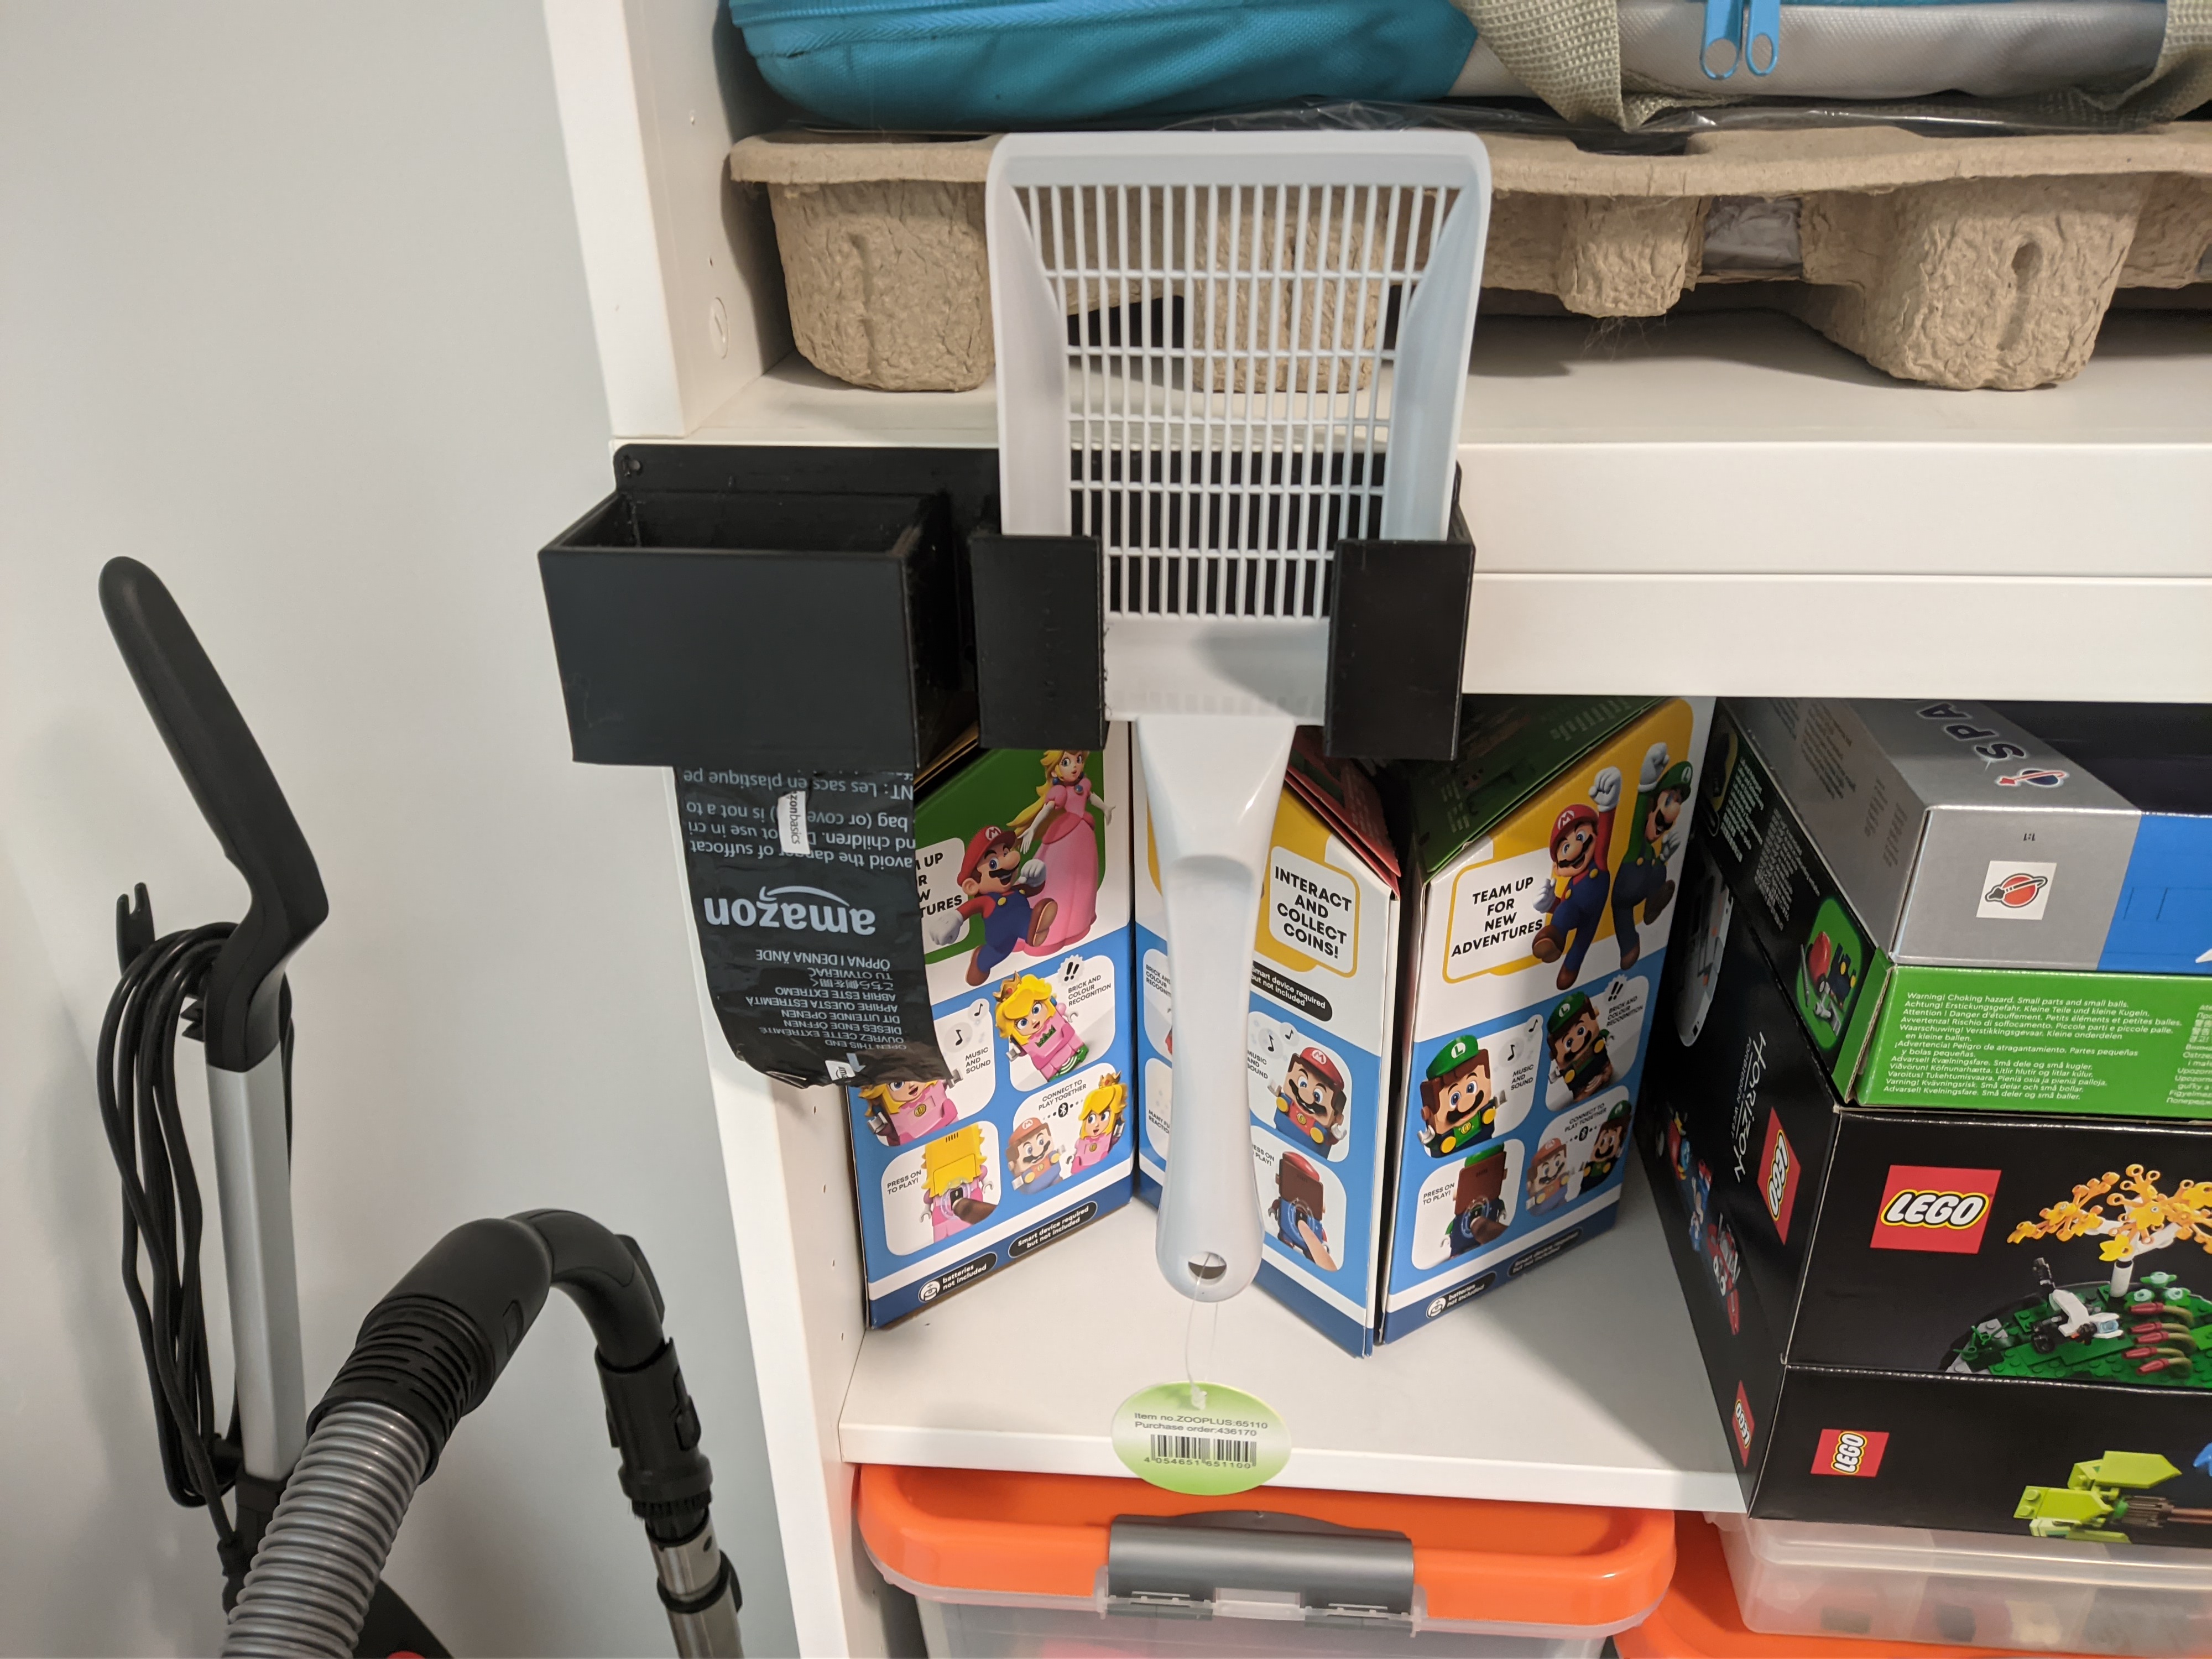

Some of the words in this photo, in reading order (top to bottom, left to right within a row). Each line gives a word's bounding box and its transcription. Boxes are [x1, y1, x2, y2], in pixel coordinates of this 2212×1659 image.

[1918, 702, 2027, 760] SPA
[709, 769, 782, 790] plastique
[788, 778, 807, 789] en
[813, 779, 846, 791] sacs
[851, 782, 877, 797] Les
[686, 802, 702, 816] to
[707, 804, 716, 814] a
[721, 805, 747, 817] not
[753, 808, 764, 822] is
[790, 793, 801, 844] zonbasics
[849, 813, 872, 829] (or
[878, 812, 908, 832] bag
[688, 822, 706, 834] cri
[711, 824, 726, 838] in
[731, 826, 757, 837] use
[690, 841, 753, 857] suffocat
[822, 832, 890, 851] children.
[758, 845, 773, 859] of
[839, 852, 864, 867] the
[870, 855, 912, 870] avoid
[924, 853, 943, 867] UP
[1275, 865, 1352, 912] INTERACT
[1473, 883, 1512, 905] TEAM
[1515, 877, 1534, 893] UP
[1295, 894, 1328, 919] AND
[1486, 899, 1514, 916] FOR
[704, 895, 876, 935] amazon
[1484, 912, 1516, 932] NEW
[1277, 902, 1347, 944] COLLECT
[1284, 923, 1339, 959] COINS!
[1451, 919, 1543, 957] ADVENTURES
[755, 950, 790, 964] ÄNDE
[794, 952, 837, 966] DENNA
[847, 956, 890, 971] ÖPPNA
[875, 972, 893, 980] TU
[1068, 981, 1086, 994] BRICK
[1087, 974, 1102, 987] AND
[1068, 984, 1095, 999] COLOUR
[1272, 974, 1295, 993] device
[1296, 988, 1326, 1009] required
[775, 987, 828, 998] EXTREMO
[831, 990, 859, 1000] ESTE
[862, 992, 896, 1001] ABRIR
[1068, 983, 1112, 1006] RECOGNITION
[1262, 979, 1274, 991] not
[1275, 985, 1305, 1007] included
[1907, 992, 1945, 1001] Warning!
[1948, 994, 1983, 1003] Choking
[1985, 995, 2014, 1003] hazard.
[745, 997, 807, 1008] ESTREMITÀ
[810, 1000, 855, 1011] QUESTA
[858, 1003, 898, 1013] APRIRE
[1905, 1000, 1943, 1009] Achtung!
[1945, 1002, 2021, 1012] Erstickungsgefahr.
[781, 1009, 827, 1020] OPENEN
[830, 1013, 879, 1022] UITEINDE
[883, 1015, 900, 1024] DIT
[1903, 1008, 1942, 1016] Attention
[1949, 1010, 1980, 1019] Danger
[2071, 1014, 2109, 1022] éléments
[2154, 1018, 2182, 1026] balles.
[784, 1020, 828, 1031] ÖFFNEN
[832, 1022, 859, 1031] ENDE
[863, 1024, 901, 1035] DIESES
[1901, 1016, 1949, 1024] Avvertenza!
[1994, 1020, 2053, 1029] soffocamento.
[822, 1031, 857, 1040] CETTE
[1900, 1024, 1963, 1034] Waarschuwing!
[1966, 1027, 2044, 1037] Verstikkingsgevaar.
[860, 1034, 904, 1043] OUVREZ
[965, 1047, 989, 1061] MUSIC
[1895, 1040, 1950, 1048] ¡Advertencia!
[1953, 1042, 1981, 1051] Peligro
[1996, 1045, 2067, 1054] atragantamiento.
[966, 1058, 981, 1068] AND
[966, 1059, 992, 1074] SOUND
[1511, 1073, 1526, 1084] AND
[1512, 1065, 1534, 1077] MUSIC
[1042, 1083, 1072, 1102] CONNECT
[1072, 1080, 1083, 1089] TO
[1511, 1077, 1533, 1091] SOUND
[1039, 1097, 1056, 1110] PLAY
[1055, 1084, 1087, 1104] TOGETHER
[887, 1173, 910, 1190] PRESS
[910, 1170, 922, 1180] ON
[1768, 1129, 1789, 1220] LEGO
[887, 1186, 899, 1194] TO
[898, 1177, 919, 1191] PLAY!
[1423, 1187, 1444, 1199] PRESS
[1423, 1197, 1432, 1206] TO
[1432, 1190, 1451, 1203] PLAY!
[1882, 1191, 1988, 1228] LEGO
[1018, 1232, 1038, 1247] Smart
[1039, 1221, 1061, 1238] device
[1061, 1206, 1089, 1227] required
[1027, 1237, 1039, 1248] but
[1040, 1233, 1051, 1243] not
[1052, 1217, 1080, 1236] included
[942, 1264, 974, 1284] batteries
[943, 1279, 956, 1290] not
[957, 1263, 987, 1284] included
[1135, 1421, 1183, 1431] Purchase
[1186, 1425, 1257, 1436] order:436170
[1734, 1400, 1751, 1448] LEGO
[1832, 1432, 1866, 1474] LEGO
[1206, 1460, 1251, 1469] 651100
